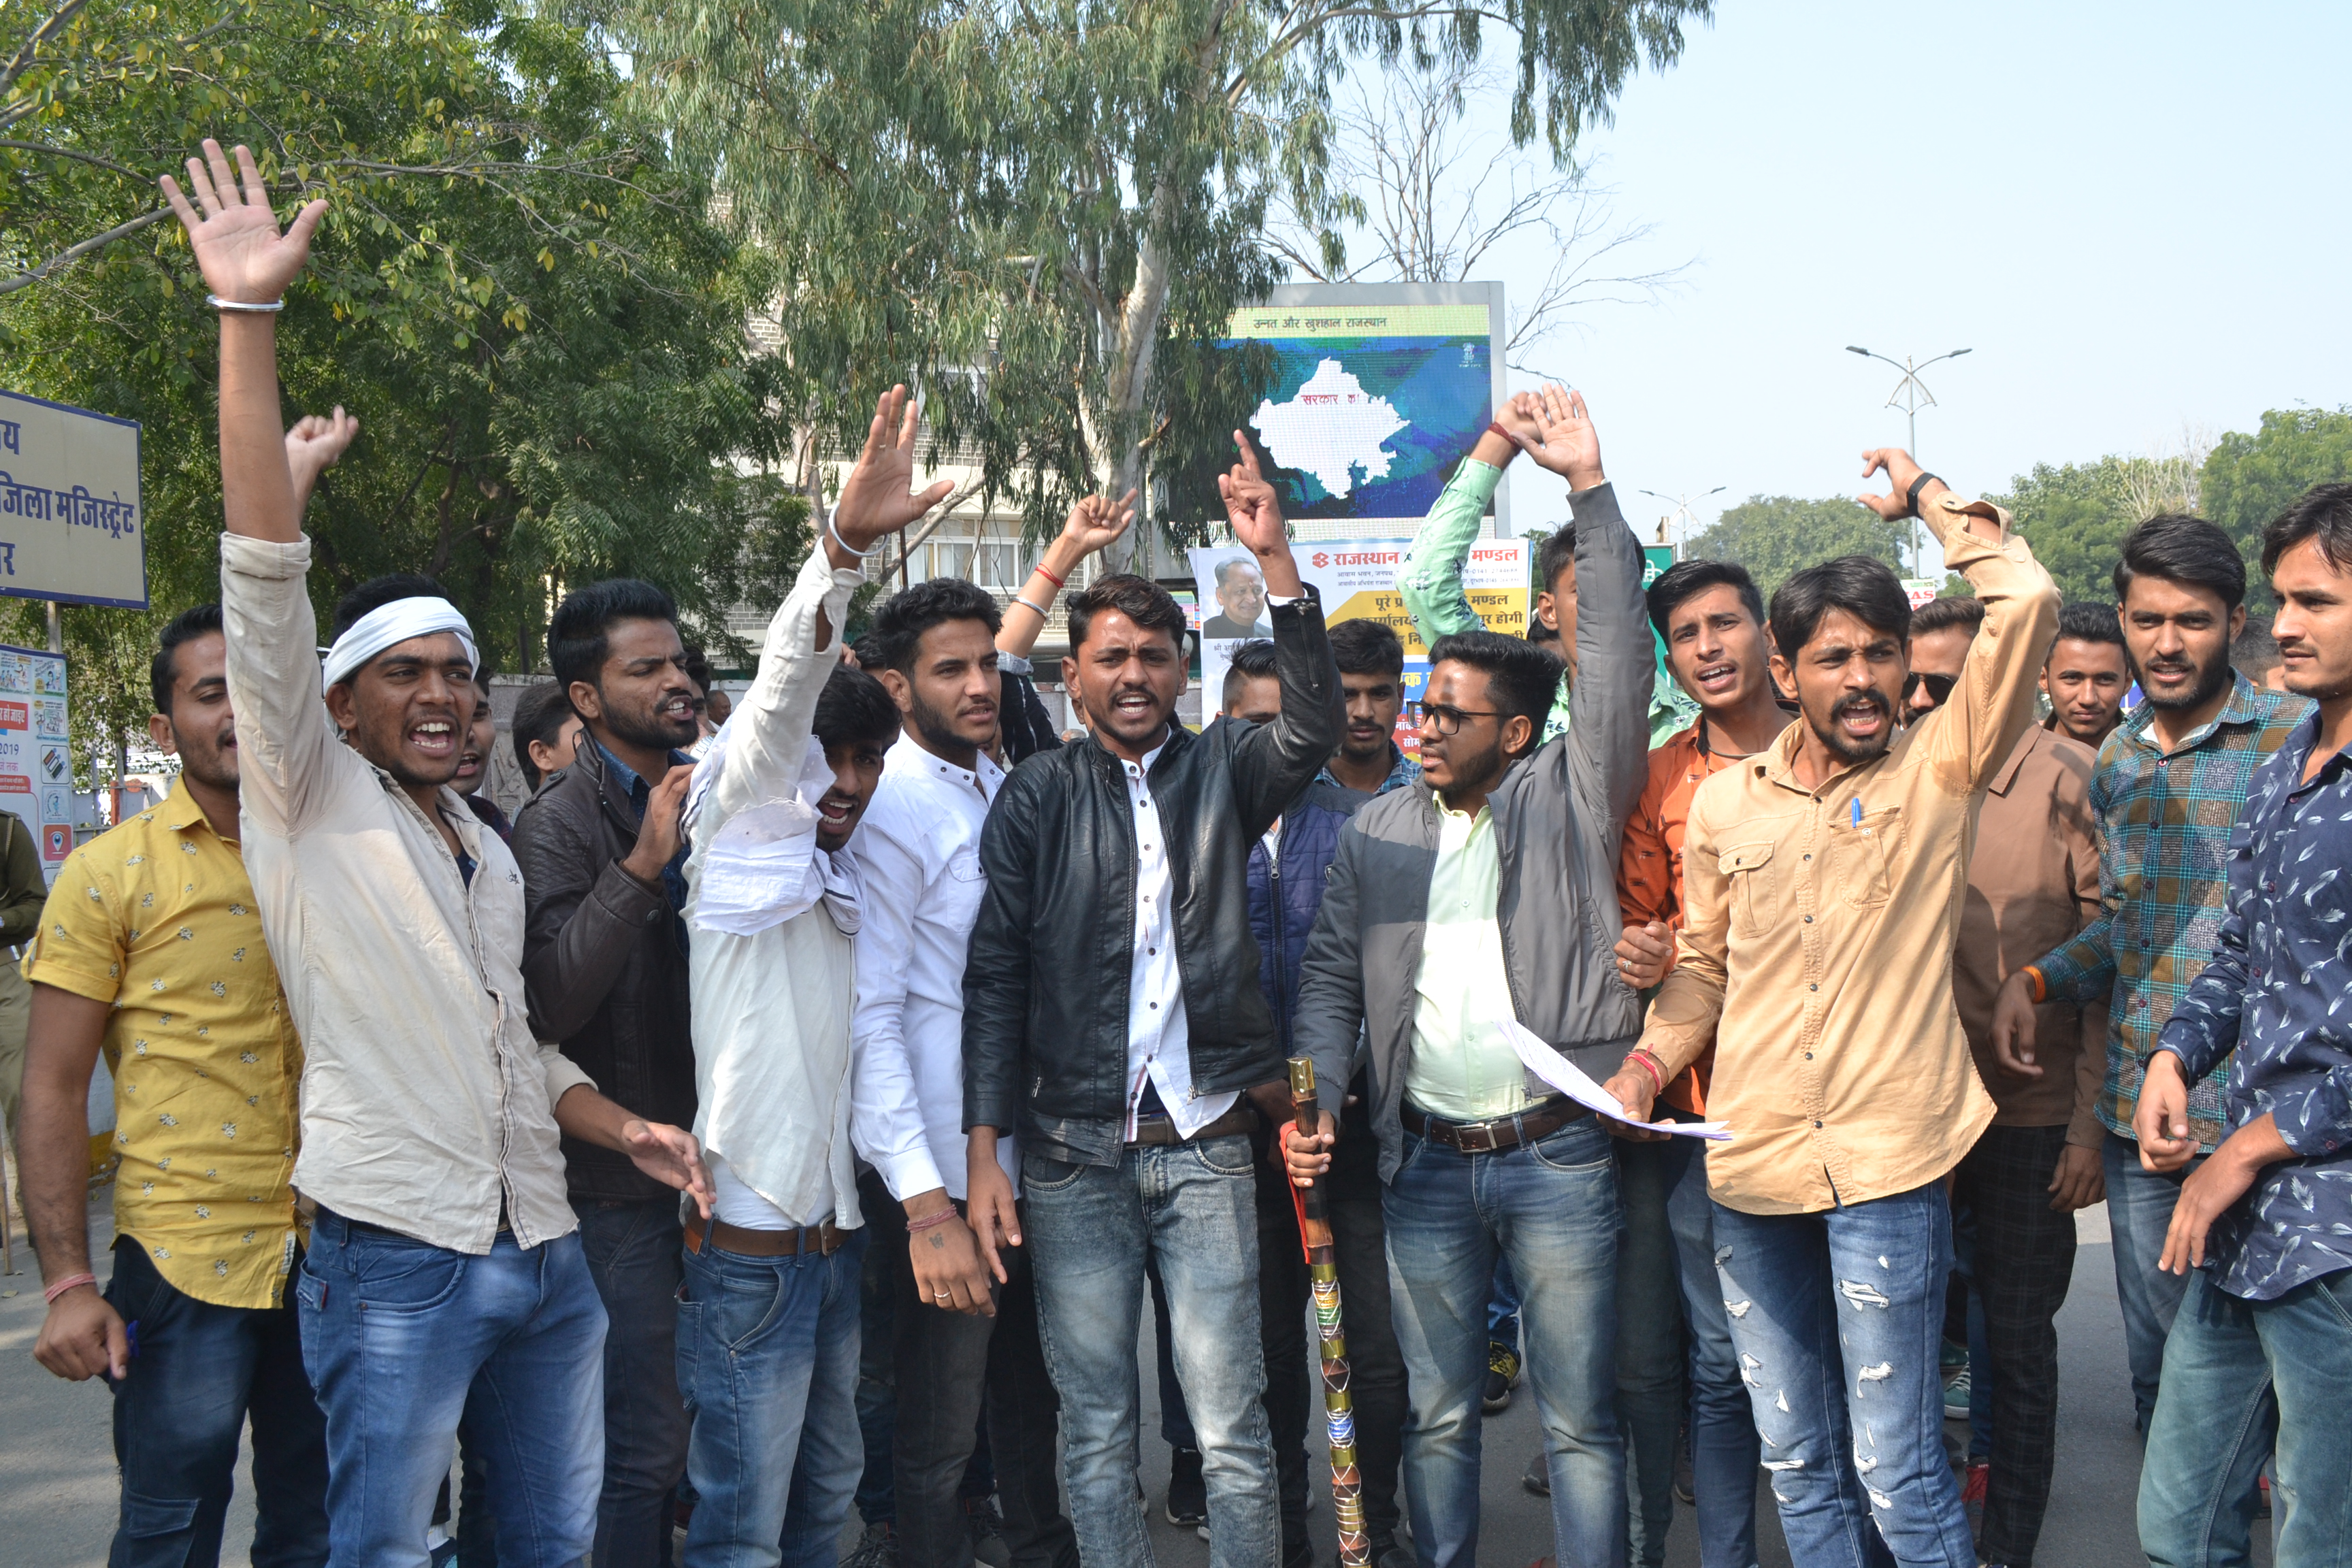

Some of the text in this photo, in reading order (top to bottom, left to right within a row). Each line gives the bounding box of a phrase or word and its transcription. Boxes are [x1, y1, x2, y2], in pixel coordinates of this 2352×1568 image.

[1254, 316, 1387, 331] उन्नत और खुशहाल राजस्थान
[1301, 394, 1338, 406] सरकार
[1333, 549, 1519, 566] राजस्थान मण्डल
[1906, 590, 1934, 600] AS
[1375, 595, 1391, 611] पूरे
[1471, 595, 1509, 606] मण्डल
[1496, 611, 1523, 624] होगी
